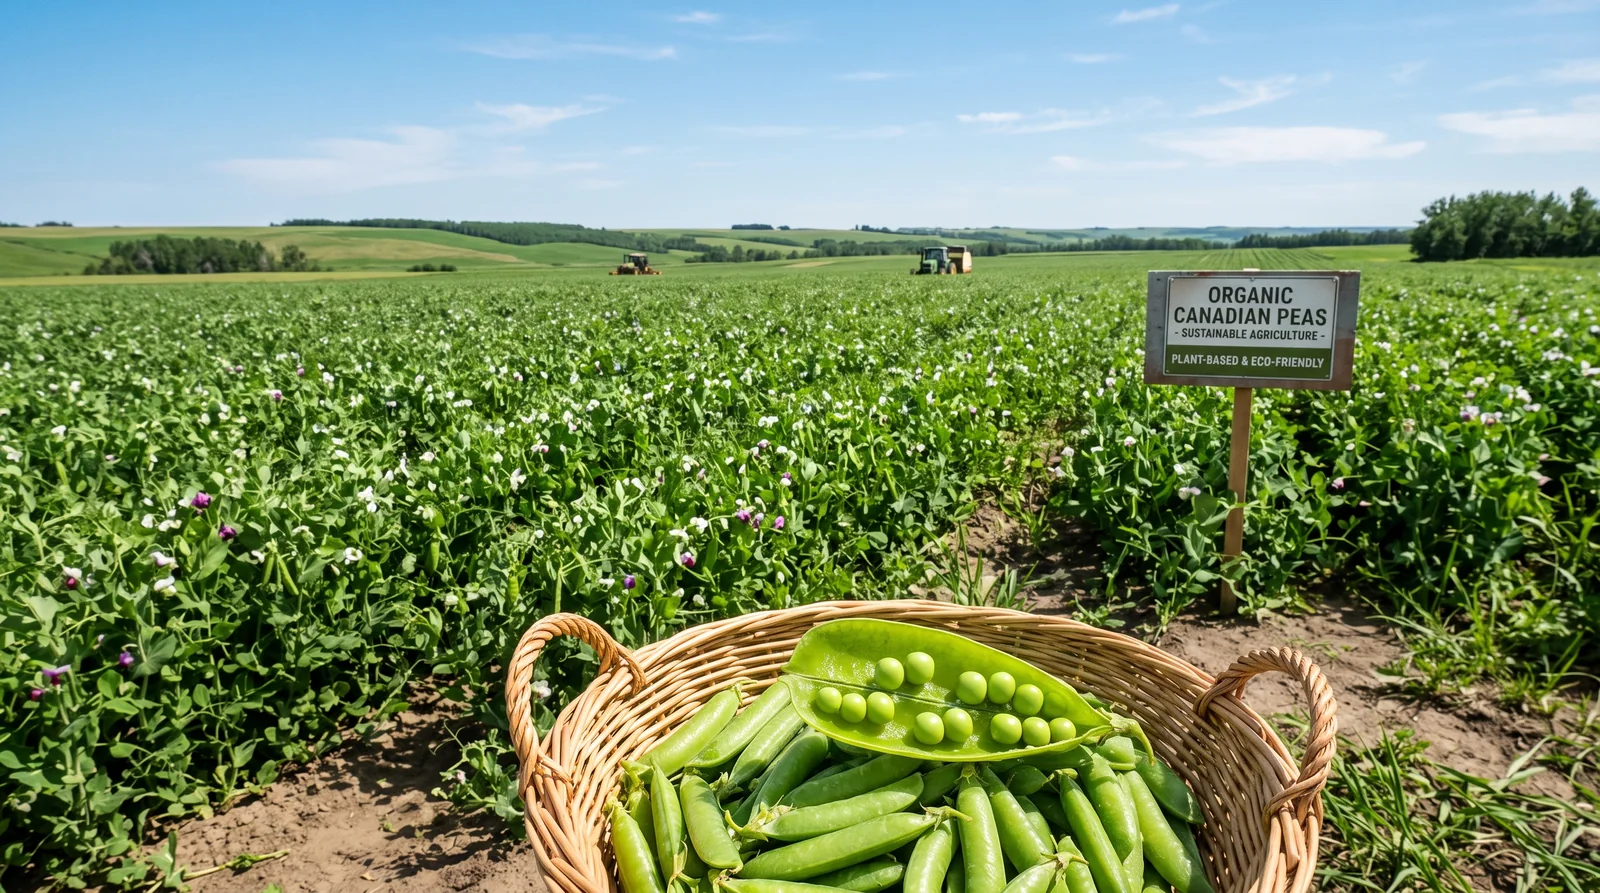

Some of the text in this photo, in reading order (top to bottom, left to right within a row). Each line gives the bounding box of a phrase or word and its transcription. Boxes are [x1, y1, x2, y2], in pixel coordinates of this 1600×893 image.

[1208, 286, 1293, 304] ORGANIC
[1173, 306, 1327, 326] CANADIAN PEAS
[1181, 328, 1247, 339] SUSTAINABLE
[1249, 329, 1318, 341] AGRICULTURE
[1171, 353, 1324, 368] PLANT-BASED & ECO-FRIENDLY
